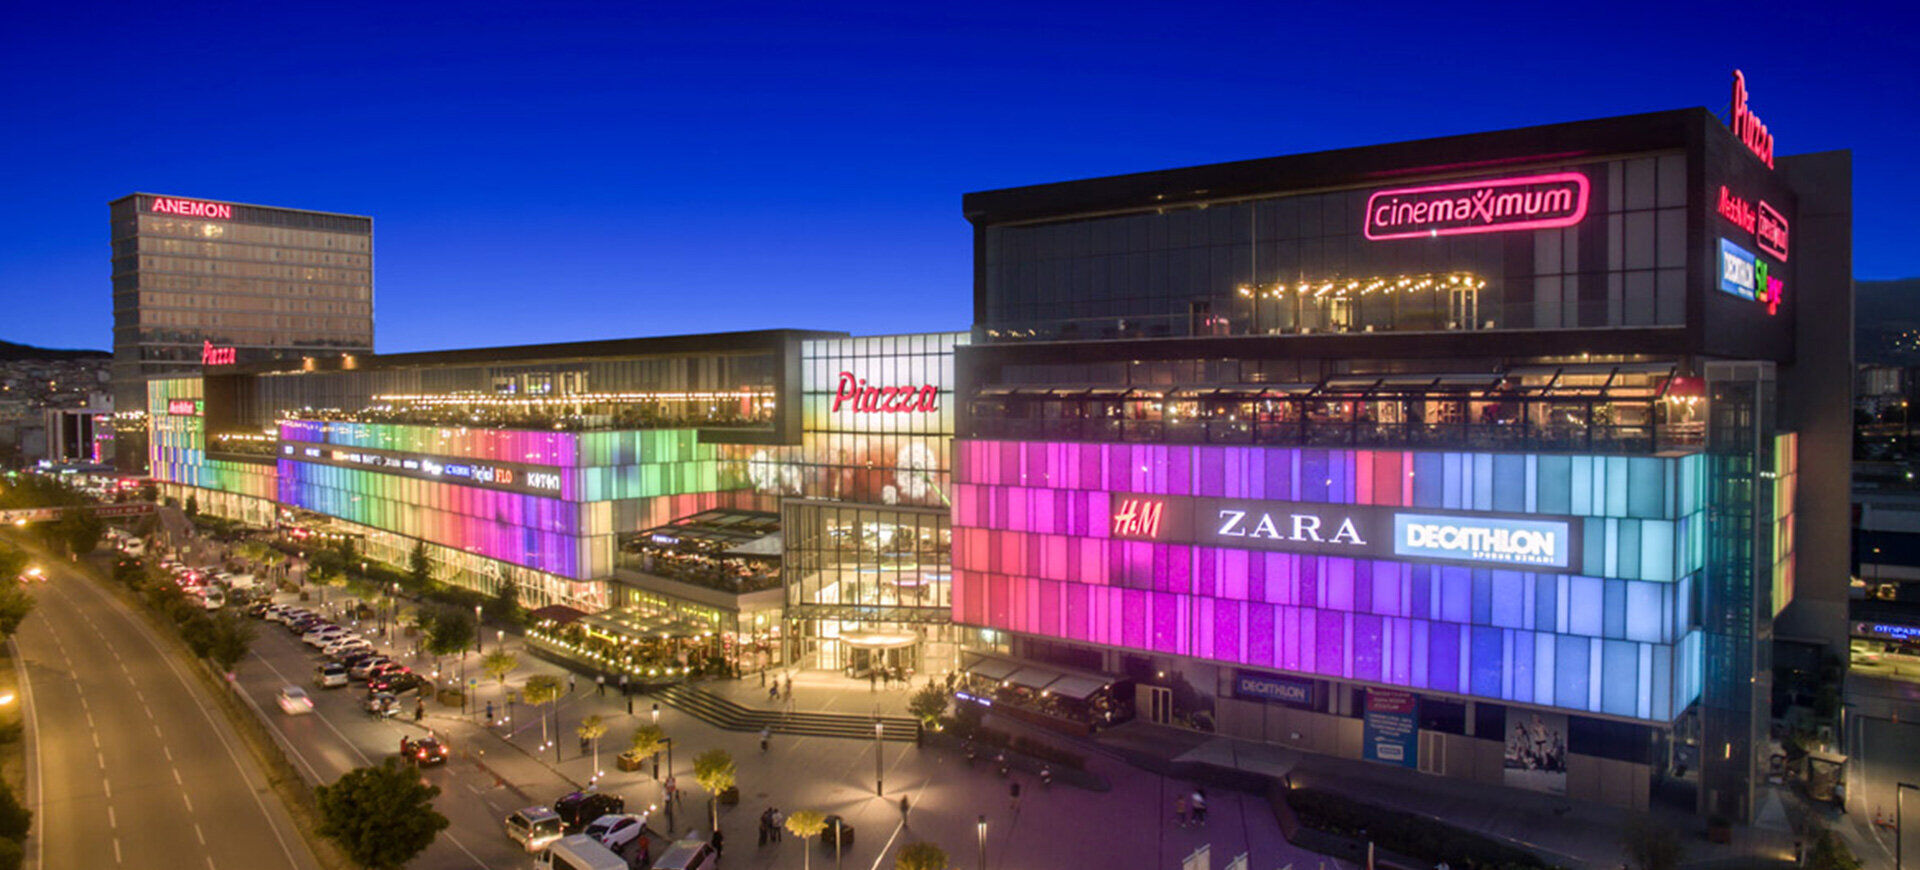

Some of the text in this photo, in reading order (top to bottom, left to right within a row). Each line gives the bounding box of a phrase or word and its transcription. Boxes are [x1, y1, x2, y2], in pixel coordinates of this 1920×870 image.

[1731, 69, 1774, 170] Piazza
[152, 198, 231, 219] ANEMON
[202, 340, 236, 365] Piazza
[832, 371, 938, 414] Piazza
[1114, 499, 1162, 538] H&M
[1218, 510, 1367, 545] ZARA
[1407, 523, 1554, 556] DECATHLON
